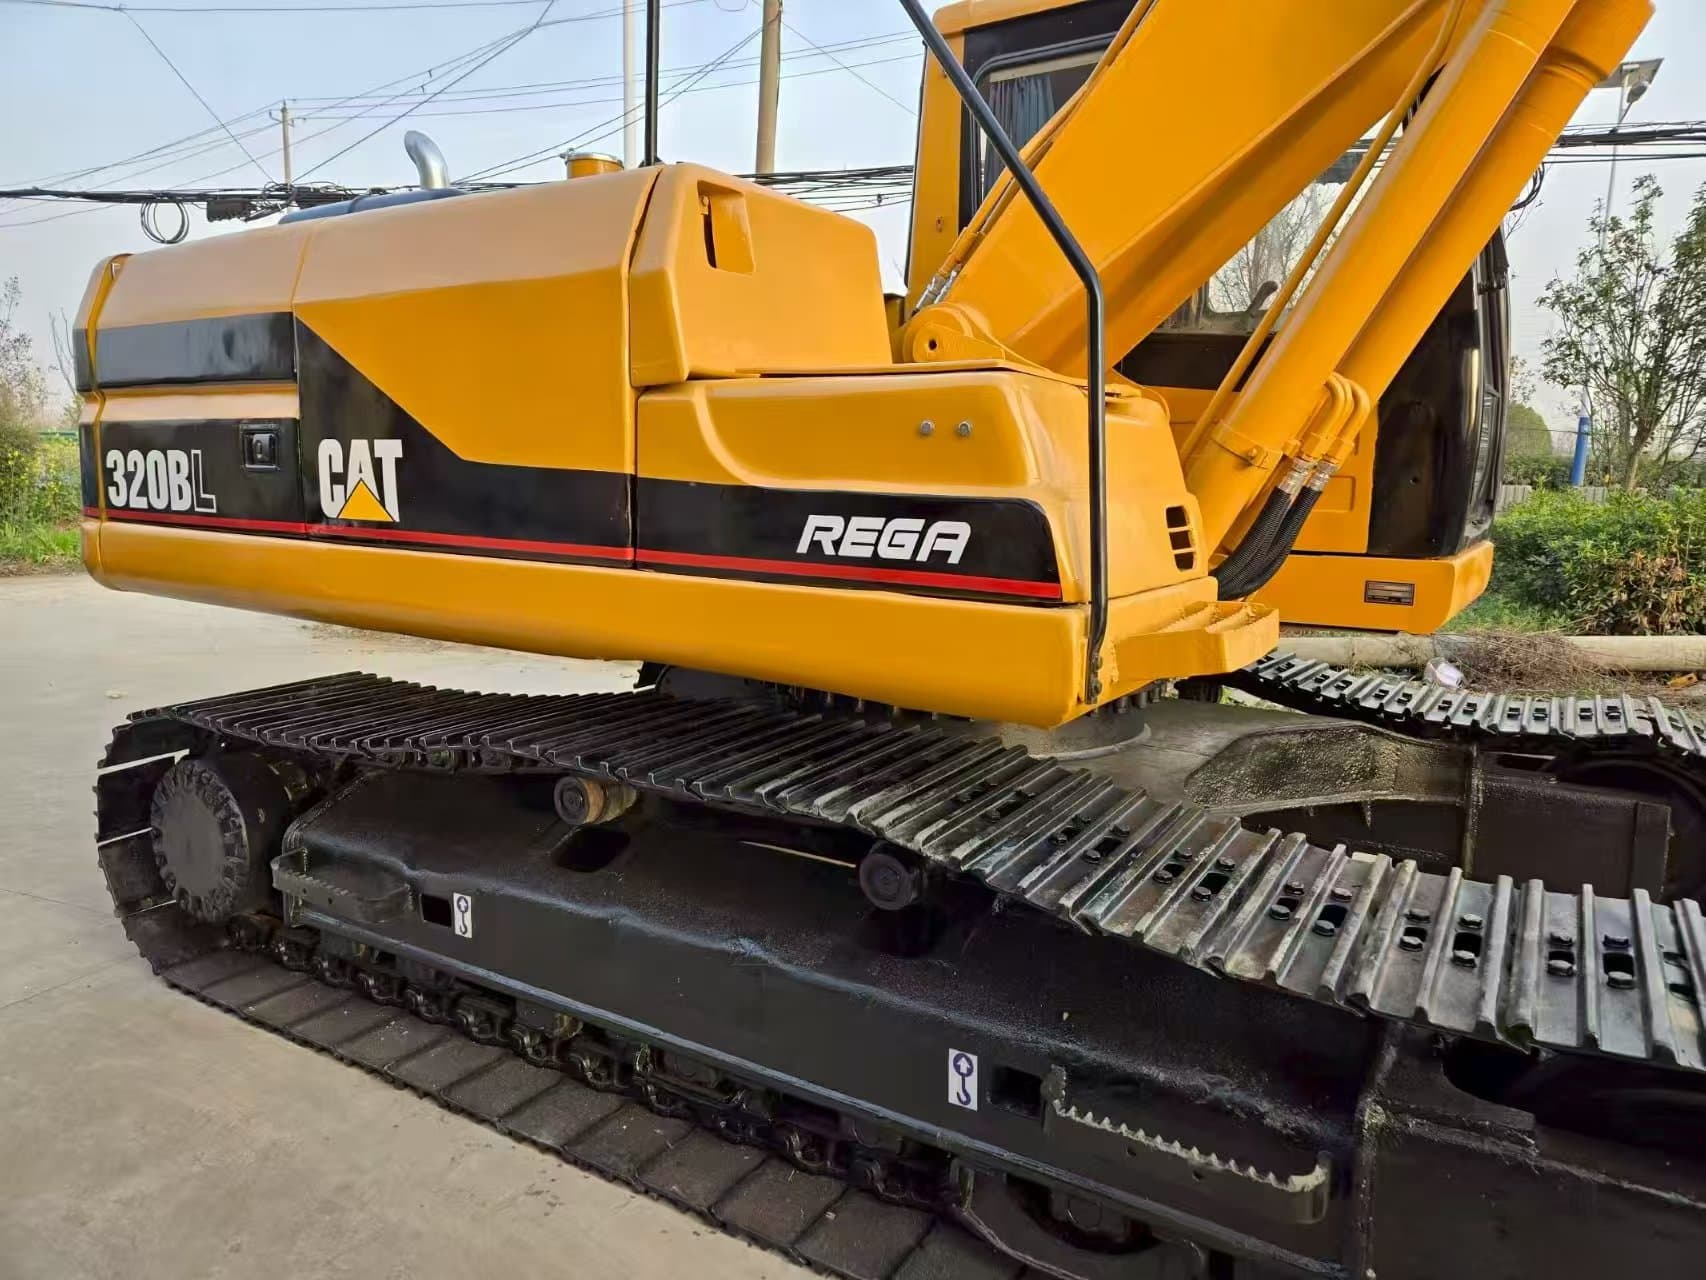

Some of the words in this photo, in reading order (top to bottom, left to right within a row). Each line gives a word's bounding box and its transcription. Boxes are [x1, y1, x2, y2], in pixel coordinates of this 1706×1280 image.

[105, 449, 217, 513] 320BL
[318, 439, 403, 522] CAT
[796, 514, 971, 564] REGA
